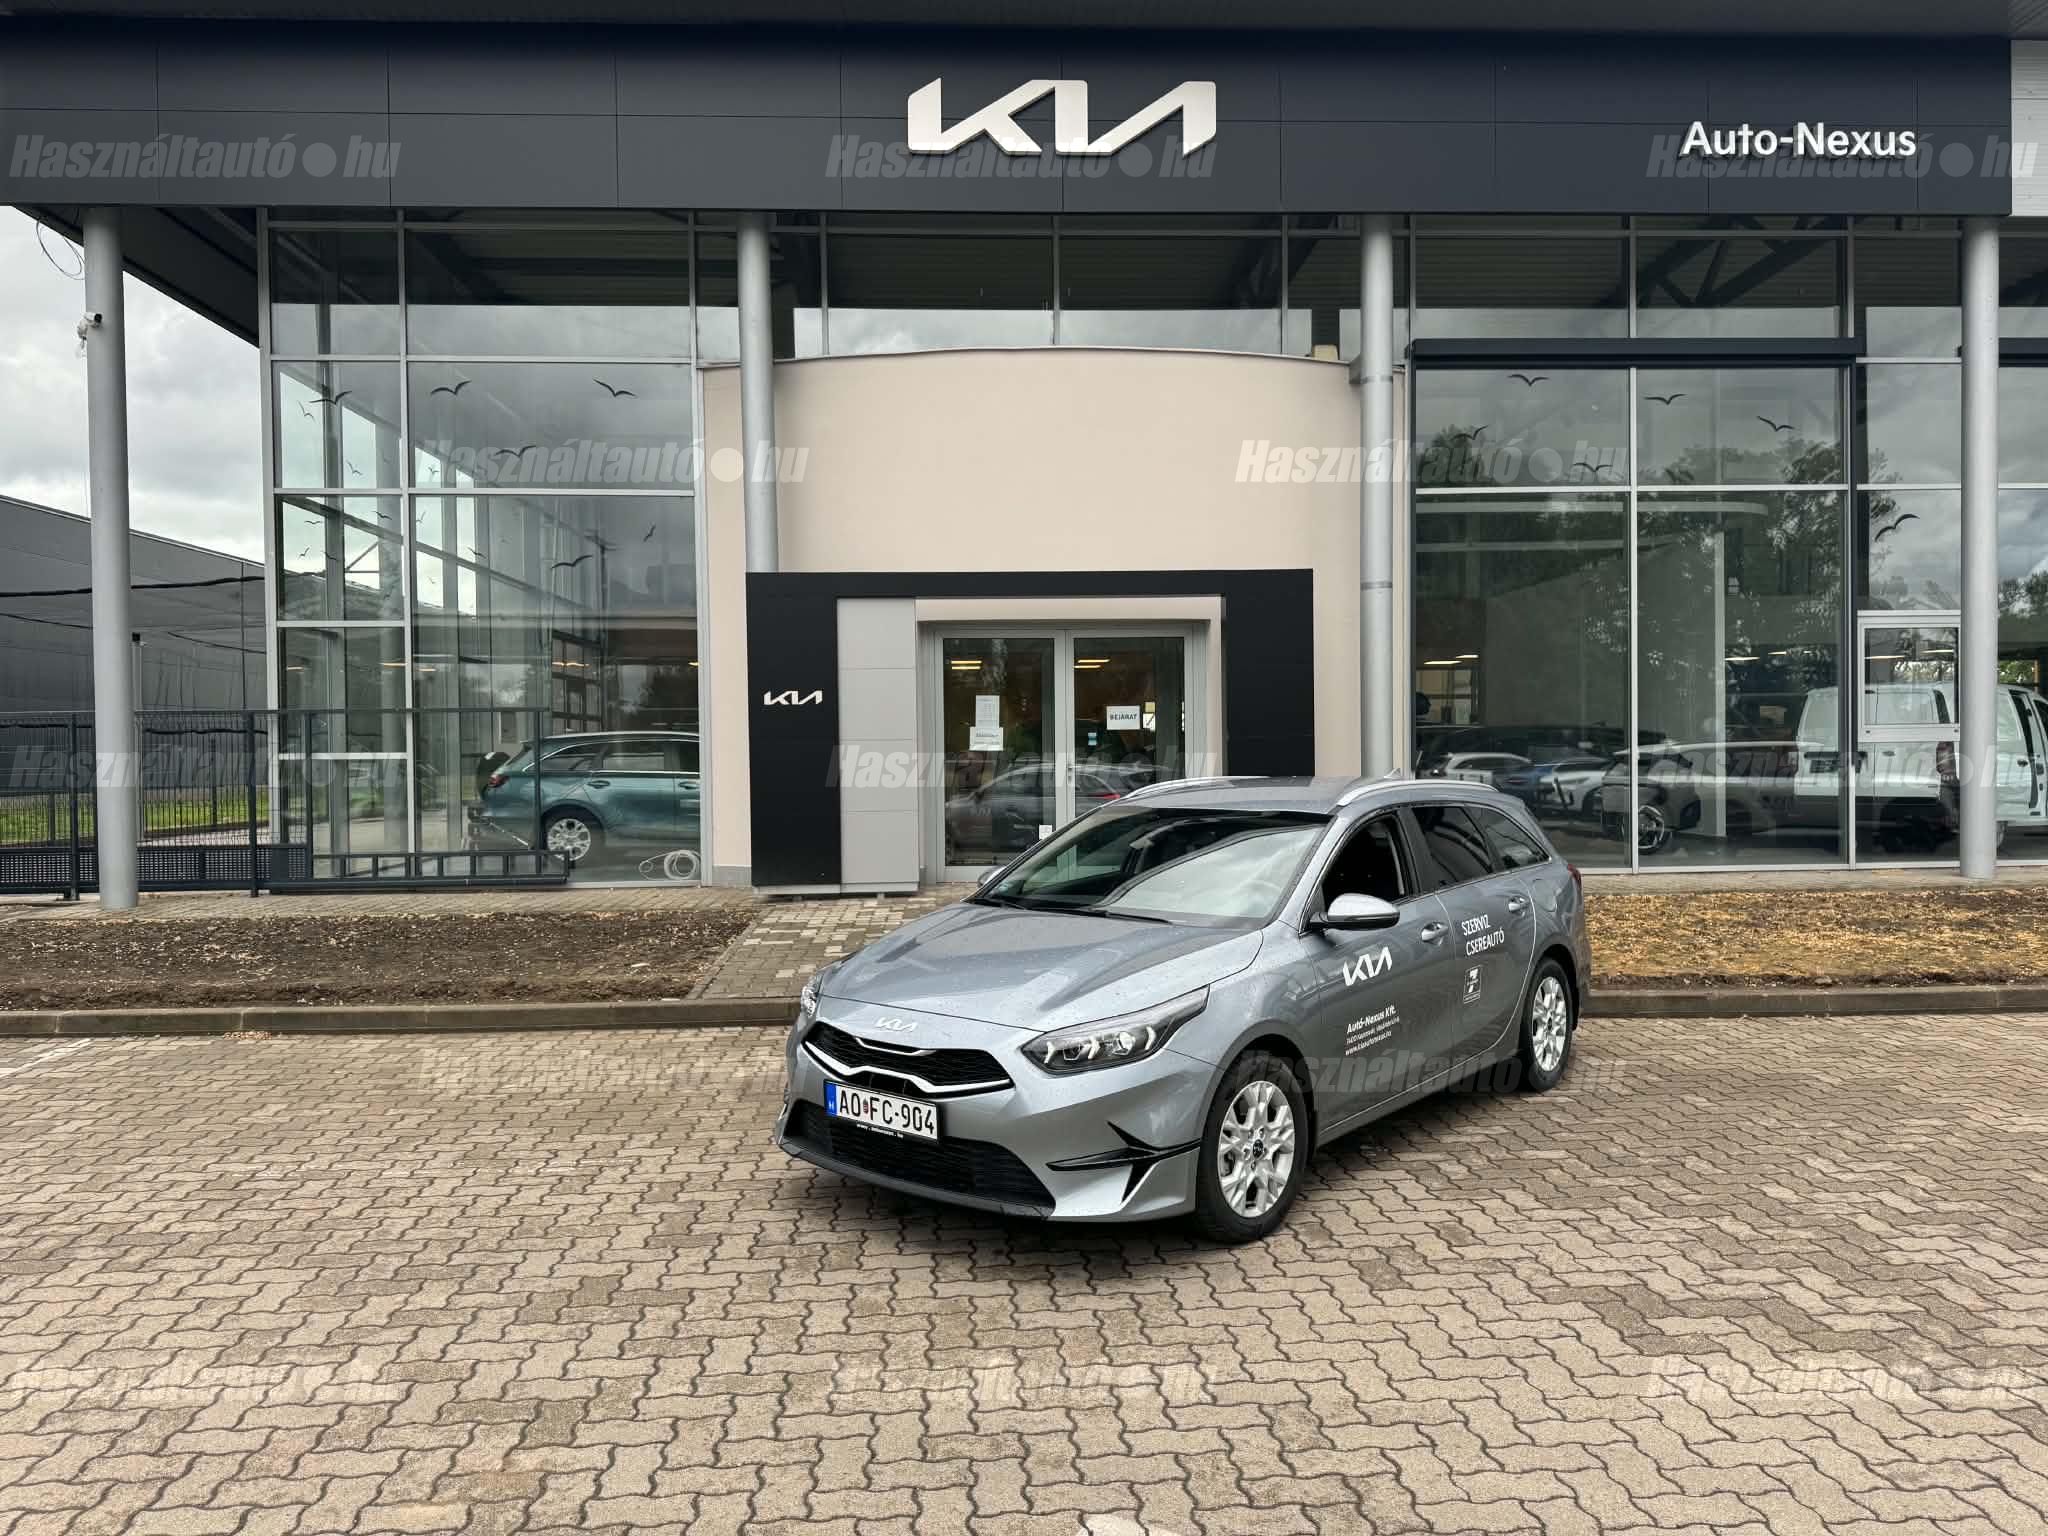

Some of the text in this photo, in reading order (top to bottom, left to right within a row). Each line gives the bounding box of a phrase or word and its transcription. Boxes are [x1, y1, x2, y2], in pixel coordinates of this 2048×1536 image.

[1680, 121, 1917, 157] Auto-Nexus
[1461, 914, 1491, 937] SZERVIZ
[1466, 927, 1505, 956] CSEREAUTÓ
[869, 1096, 935, 1135] FC-904
